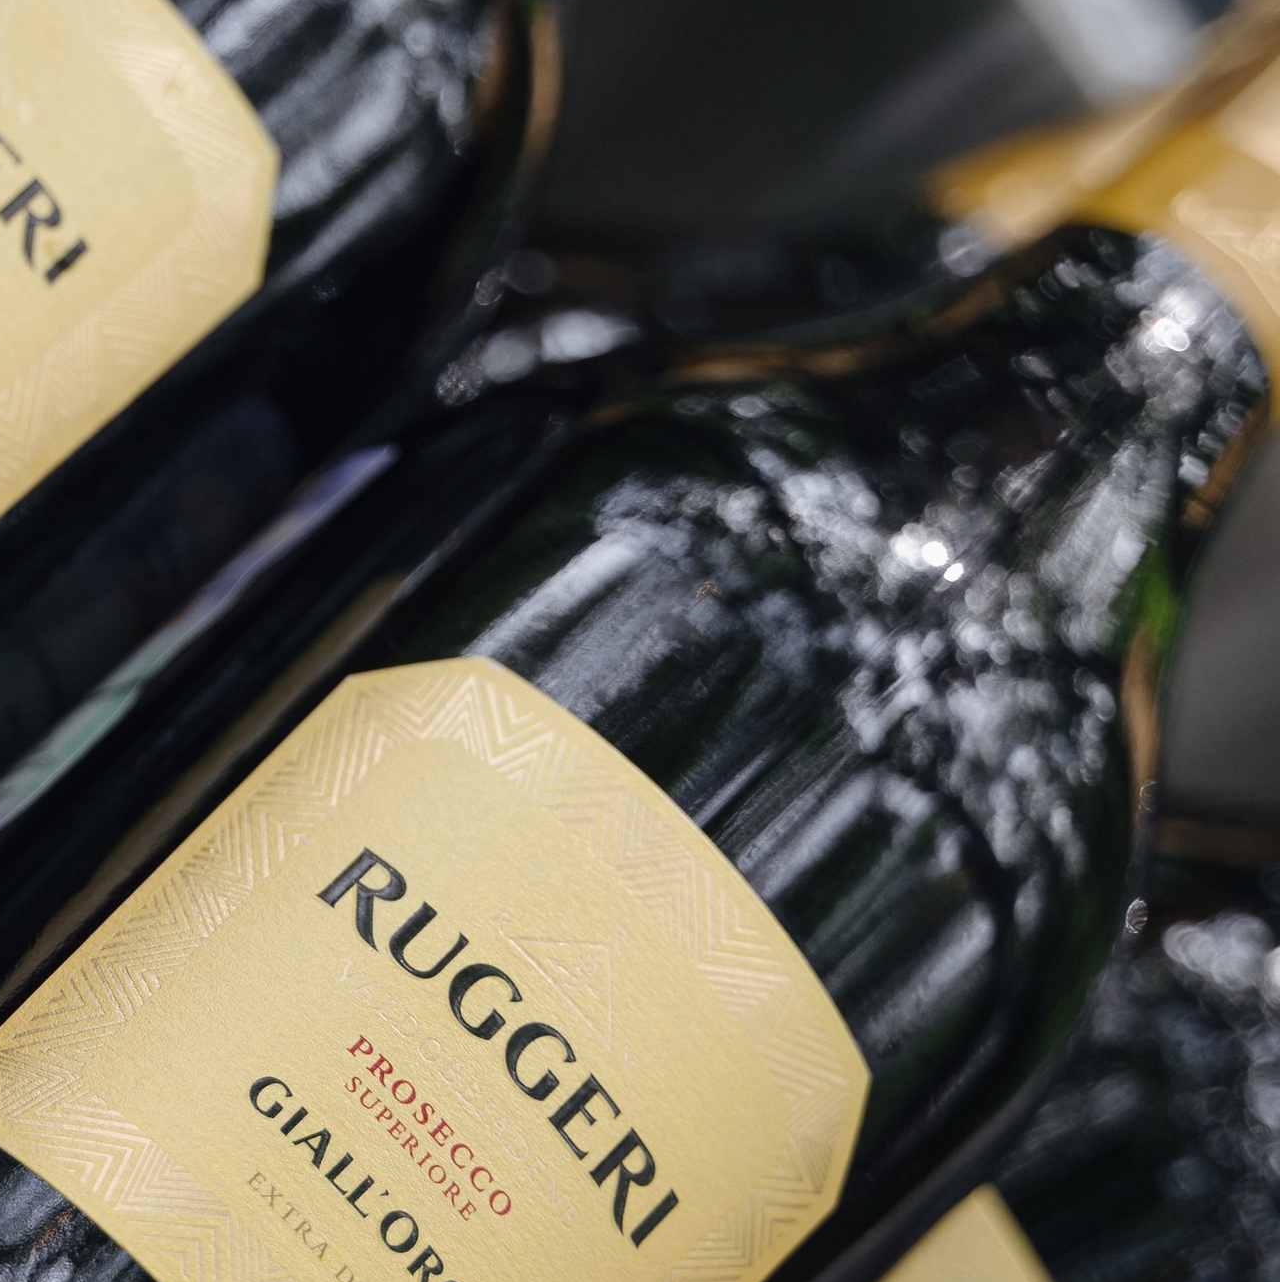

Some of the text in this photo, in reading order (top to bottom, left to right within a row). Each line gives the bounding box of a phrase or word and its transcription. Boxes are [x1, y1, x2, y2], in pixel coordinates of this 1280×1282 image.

[314, 846, 681, 1250] RUGGERI
[346, 1034, 513, 1217] PROSECCO
[244, 1170, 331, 1262] EXTRA
[344, 1075, 478, 1222] SUPERIORE
